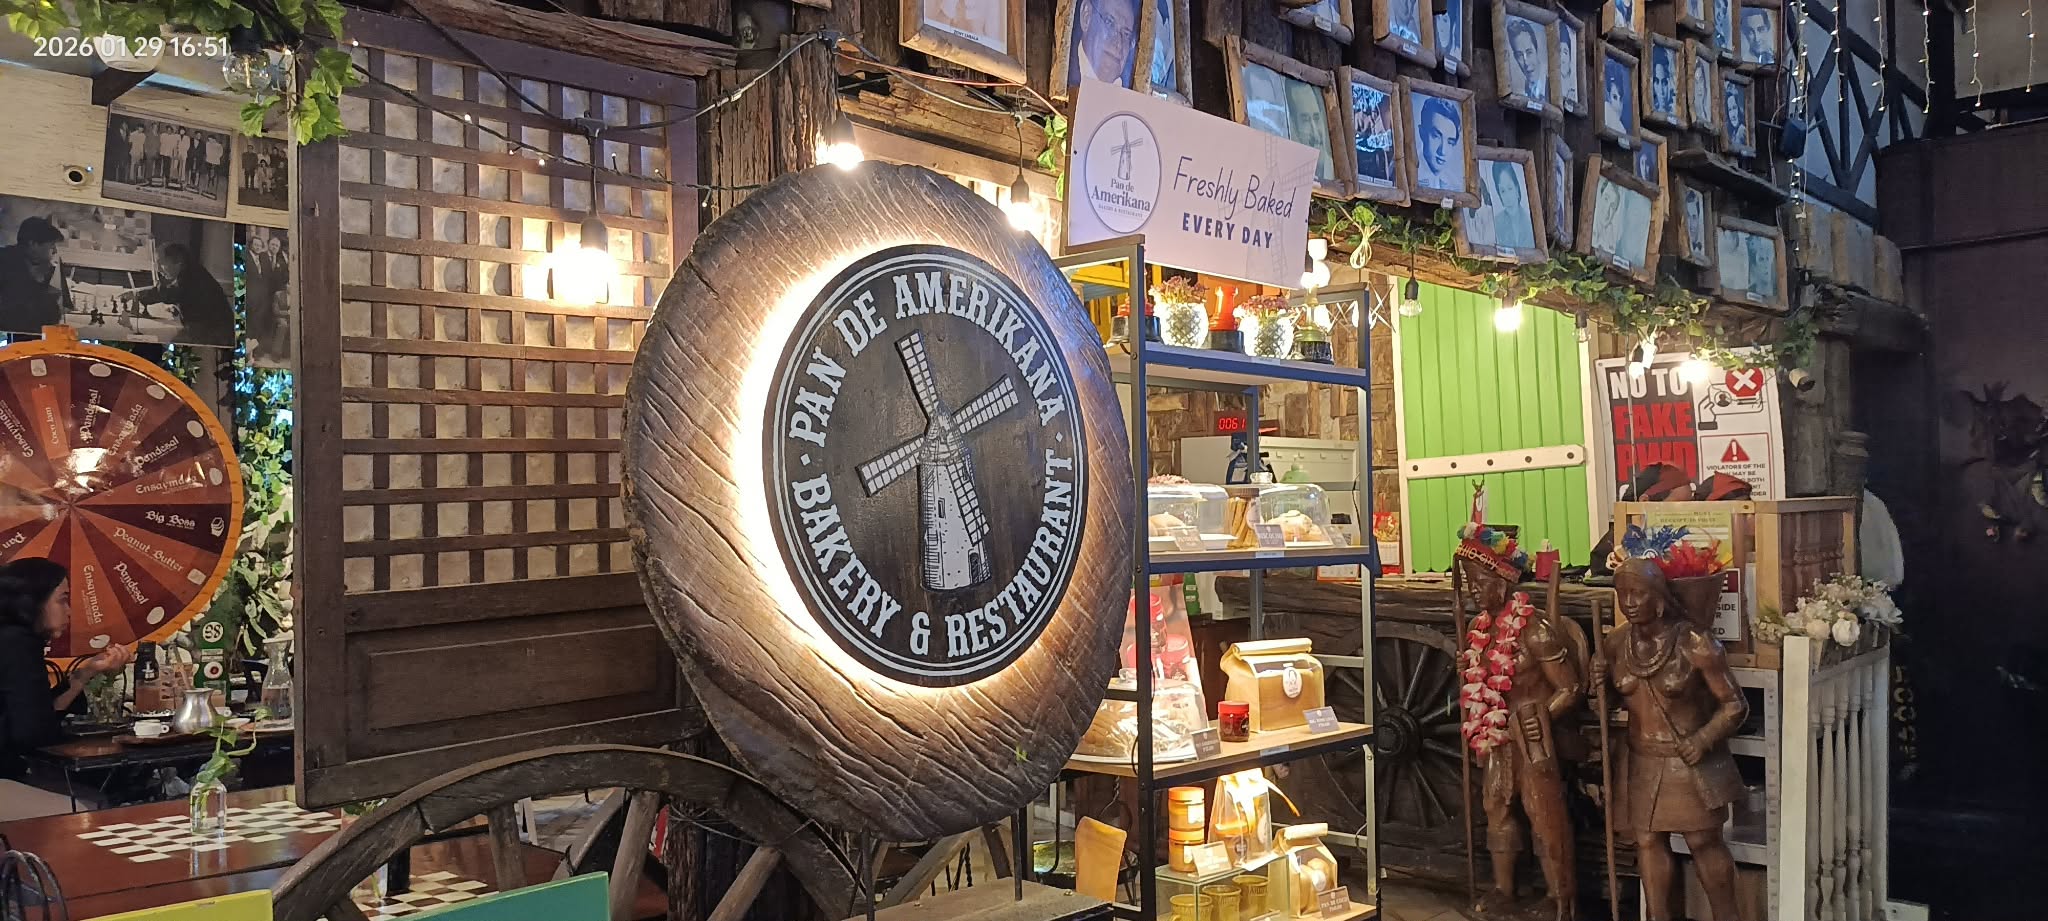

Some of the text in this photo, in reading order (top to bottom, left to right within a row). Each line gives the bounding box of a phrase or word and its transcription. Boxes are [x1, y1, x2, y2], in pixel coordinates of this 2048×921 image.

[1091, 185, 1151, 212] Amerikana
[1110, 178, 1135, 193] Pan de
[1173, 156, 1297, 220] Freshly Baked
[1182, 212, 1273, 249] EVERY DAY
[789, 271, 1065, 448] PAN DE AMERIKANA
[1609, 366, 1689, 400] NO TO
[79, 388, 99, 441] Pandesal
[1613, 401, 1694, 440] FAKE
[134, 435, 180, 468] Pandesal
[145, 510, 165, 525] Big
[168, 514, 196, 528] Boss
[2, 531, 27, 549] Pan
[113, 526, 151, 554] Peanut
[151, 548, 185, 573] Butter
[791, 449, 1073, 658] BAKERY & RESTAURANT
[82, 564, 102, 624] Ensaymada
[113, 560, 149, 606] Pandesal
